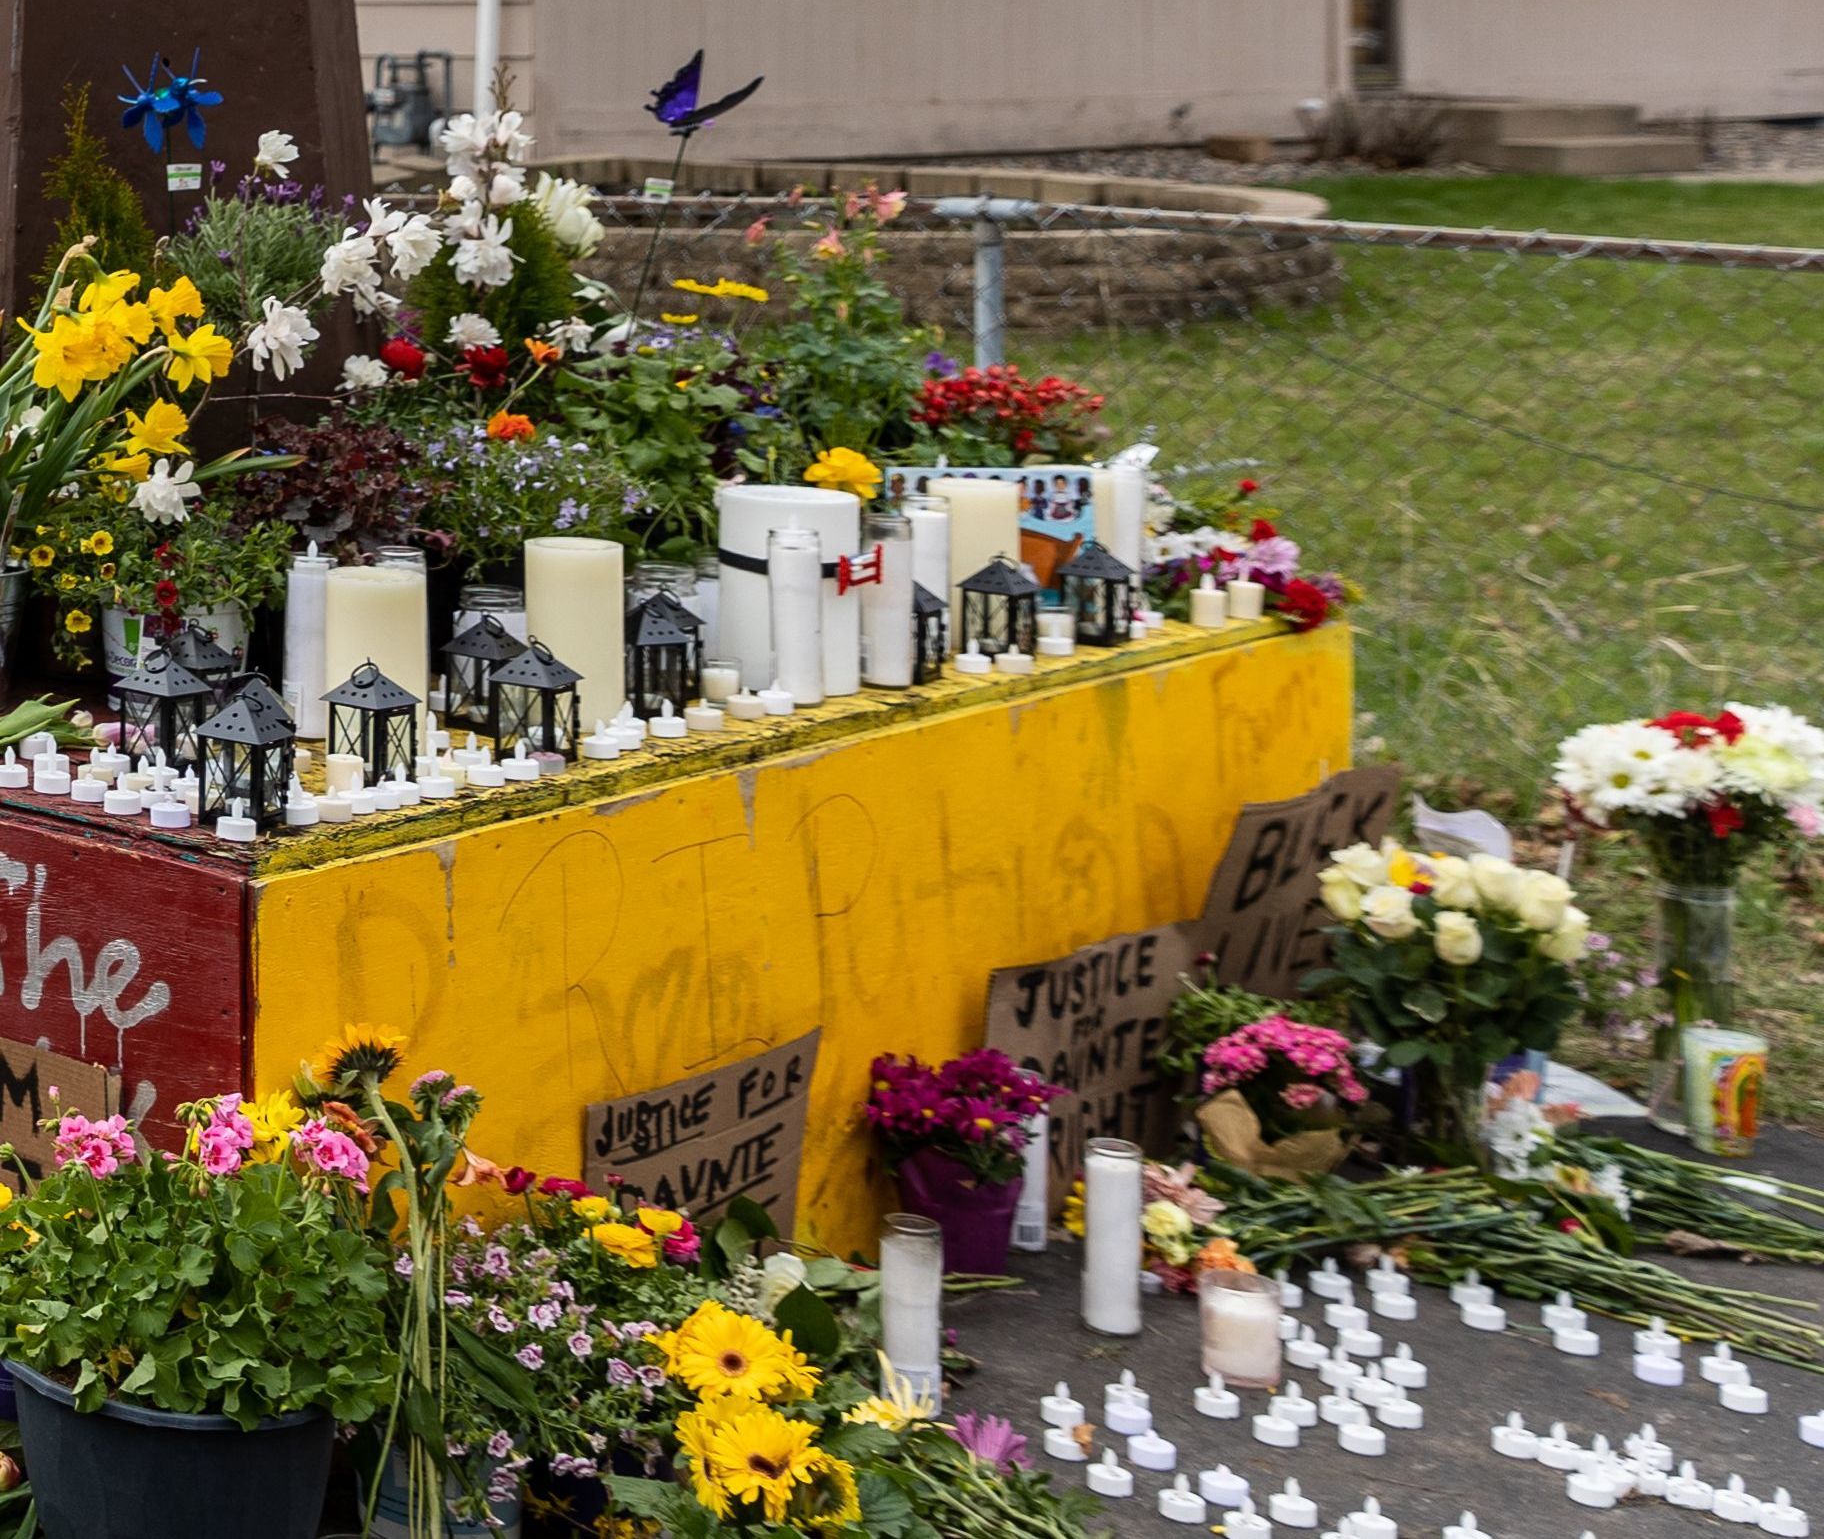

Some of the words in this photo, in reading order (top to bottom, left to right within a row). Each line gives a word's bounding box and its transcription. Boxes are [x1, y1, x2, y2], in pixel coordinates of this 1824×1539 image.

[1014, 935, 1158, 1028] JUSTICE
[595, 1081, 716, 1158] JUSTICE
[738, 1054, 803, 1119] FOR
[1052, 1081, 1162, 1177] RIGHT
